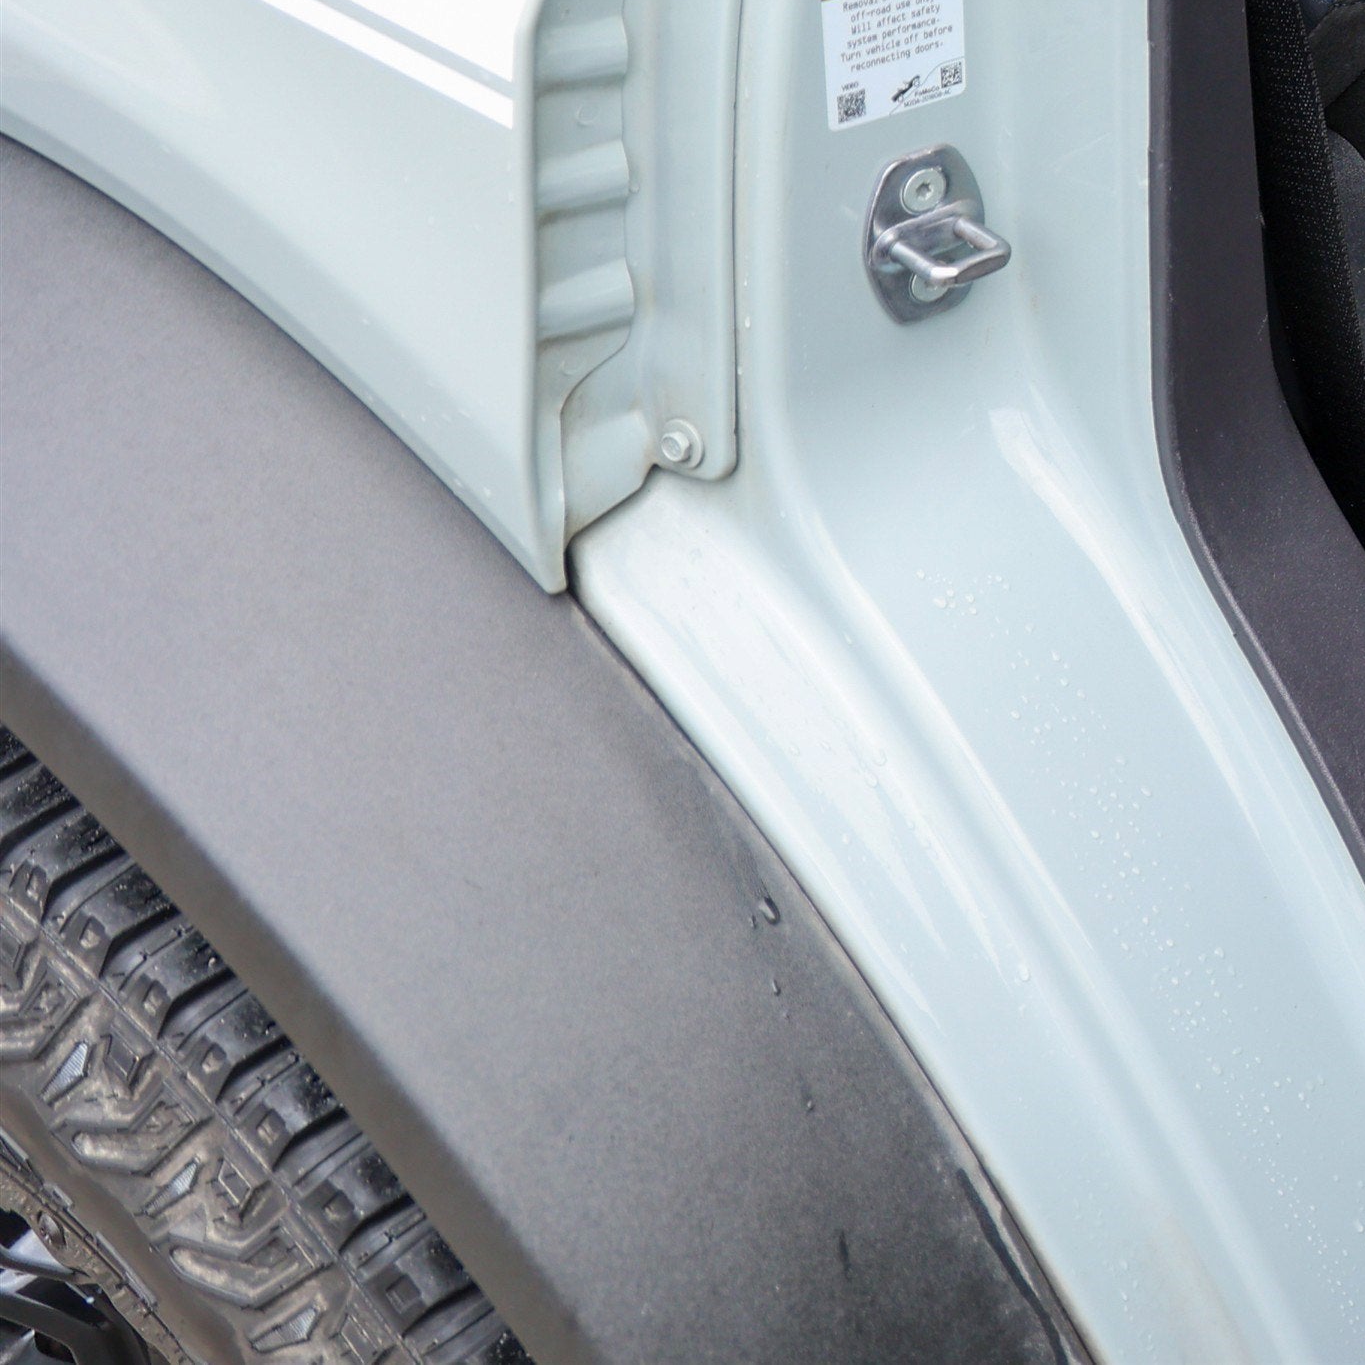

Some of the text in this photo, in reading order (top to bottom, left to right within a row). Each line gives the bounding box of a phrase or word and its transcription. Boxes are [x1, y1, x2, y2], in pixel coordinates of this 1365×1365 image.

[850, 5, 891, 23] off-road
[896, 0, 911, 10] use
[851, 4, 940, 35] Will affect safety
[841, 25, 953, 62] Turn vehicle off before
[847, 18, 940, 49] system performance.
[851, 41, 943, 72] reconnecting doors.
